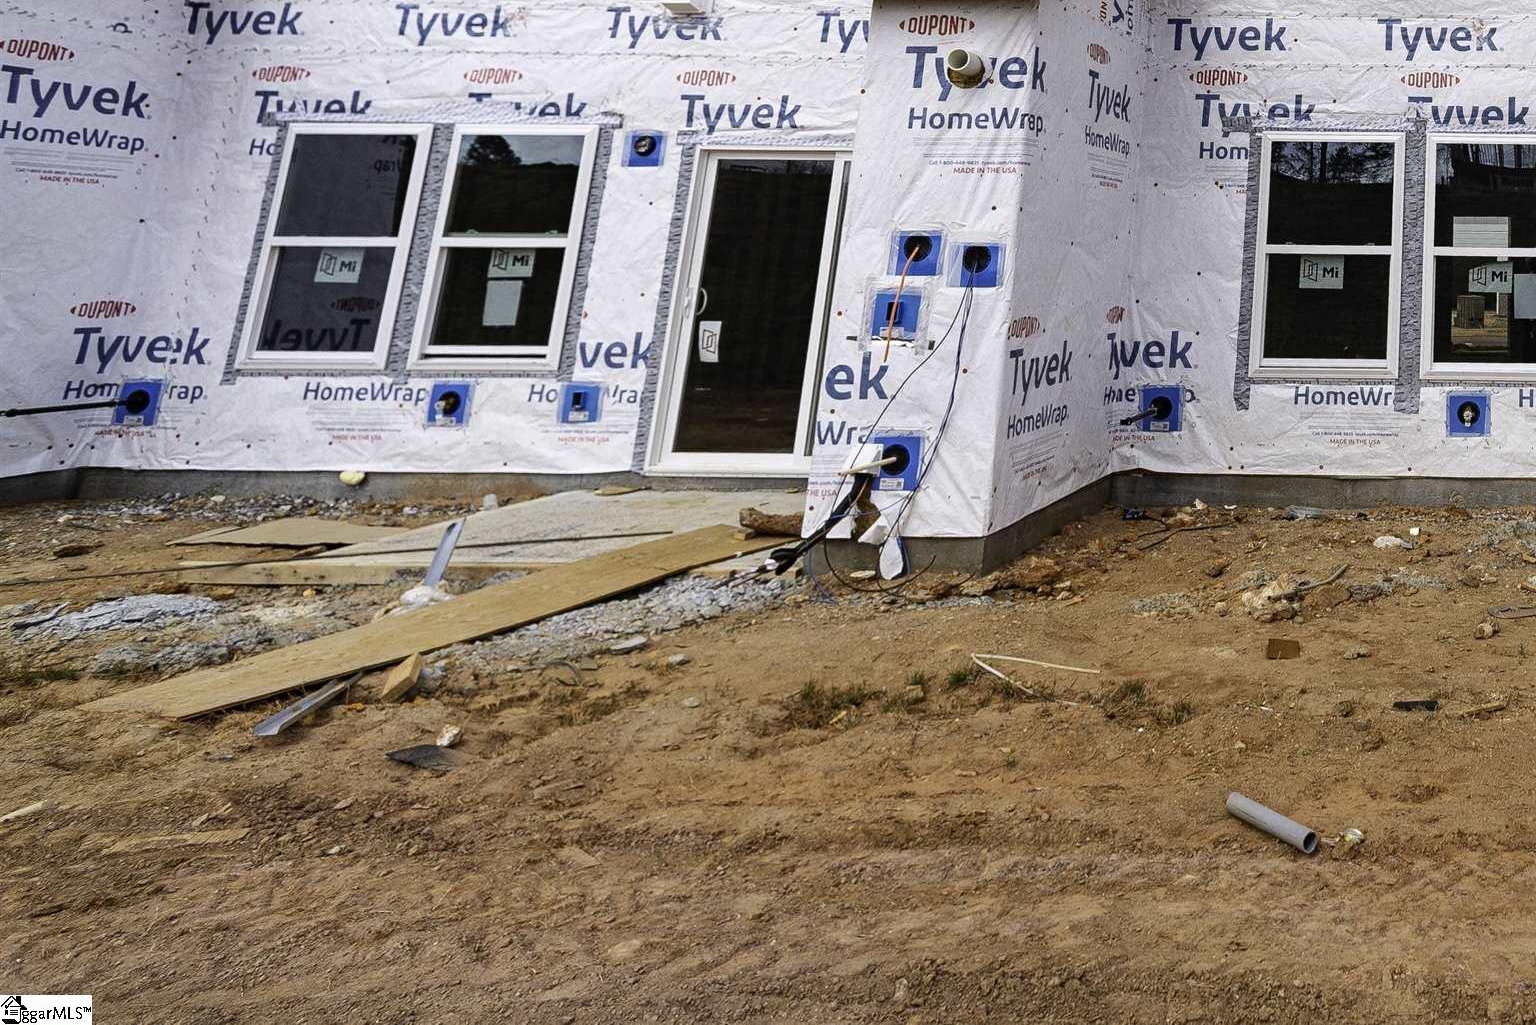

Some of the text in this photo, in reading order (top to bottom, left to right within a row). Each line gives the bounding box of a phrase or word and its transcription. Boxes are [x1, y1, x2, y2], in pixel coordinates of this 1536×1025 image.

[185, 2, 303, 44] Tyvek
[396, 4, 510, 46] Tyvek
[908, 15, 968, 36] DUPONT
[7, 40, 69, 62] DUPONT
[1168, 18, 1288, 61] Tyvek
[1377, 18, 1498, 61] Tyvek
[259, 67, 306, 82] DUPONT
[470, 69, 517, 84] DUPONT
[684, 71, 730, 86] DUPONT
[905, 46, 1047, 102] Tyek
[1196, 71, 1243, 86] DUPONT
[1408, 73, 1454, 89] DUPONT
[1, 65, 148, 120] Tyvek
[1088, 69, 1131, 123] Tyvek
[681, 94, 802, 134] Tyvek
[907, 107, 1045, 137] HomeWrap
[0, 119, 145, 153] HomeWrap
[1085, 125, 1130, 158] HomeWrap
[339, 260, 357, 273] Mi
[511, 255, 530, 267] Mi
[1322, 266, 1339, 279] Mi
[1491, 270, 1508, 283] Mi
[78, 301, 130, 318] DUPONT
[73, 326, 210, 374] Tyvek
[579, 332, 651, 369] vek
[1010, 340, 1073, 406] Tyvek
[62, 380, 204, 404] Homrap
[303, 382, 426, 406] HomeWrap
[1293, 386, 1392, 407] HomeWr
[1007, 403, 1069, 440] HomeWrap
